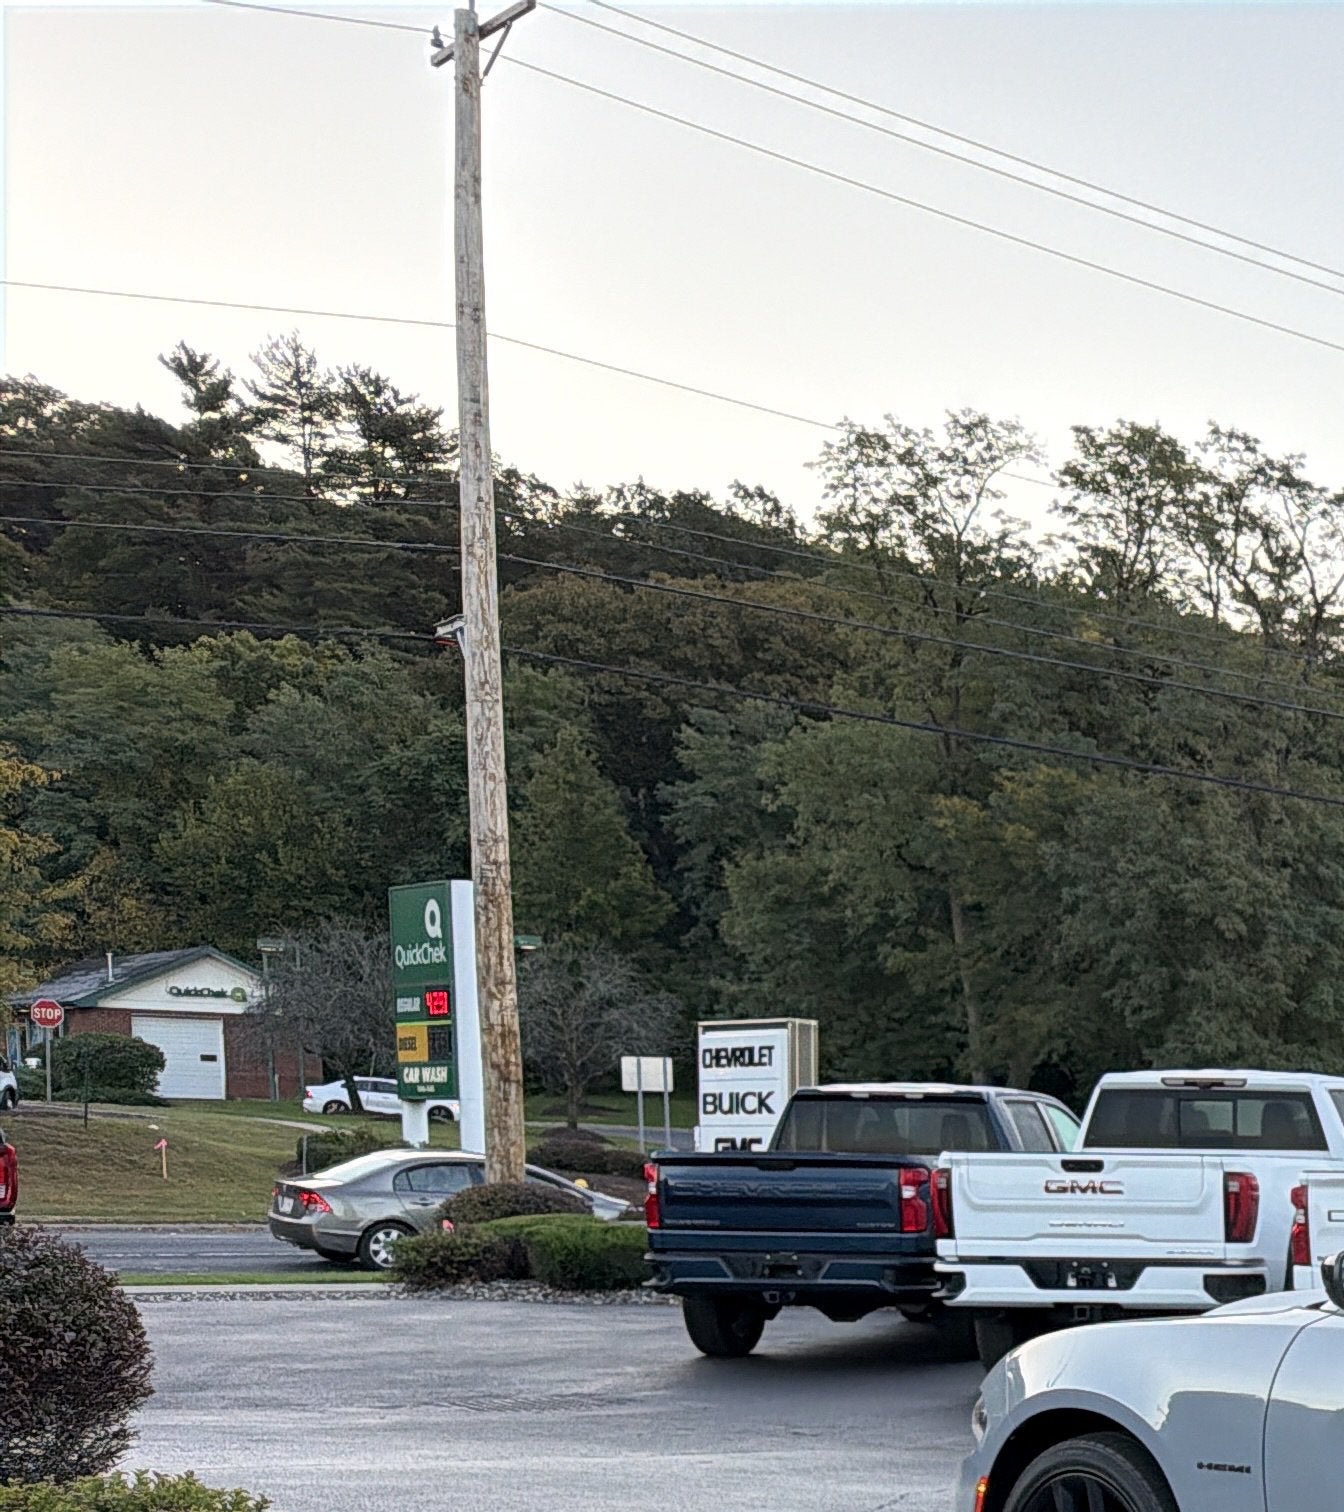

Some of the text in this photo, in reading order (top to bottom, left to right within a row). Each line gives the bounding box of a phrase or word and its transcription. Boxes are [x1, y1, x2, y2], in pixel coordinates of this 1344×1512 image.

[395, 940, 447, 970] QuickChek
[169, 985, 227, 998] QuickChek
[33, 1007, 61, 1020] STOP
[702, 1045, 775, 1069] CHEVROLET
[403, 1066, 448, 1083] CAR WASH
[702, 1091, 775, 1115] BUICK
[1044, 1180, 1124, 1195] GMC
